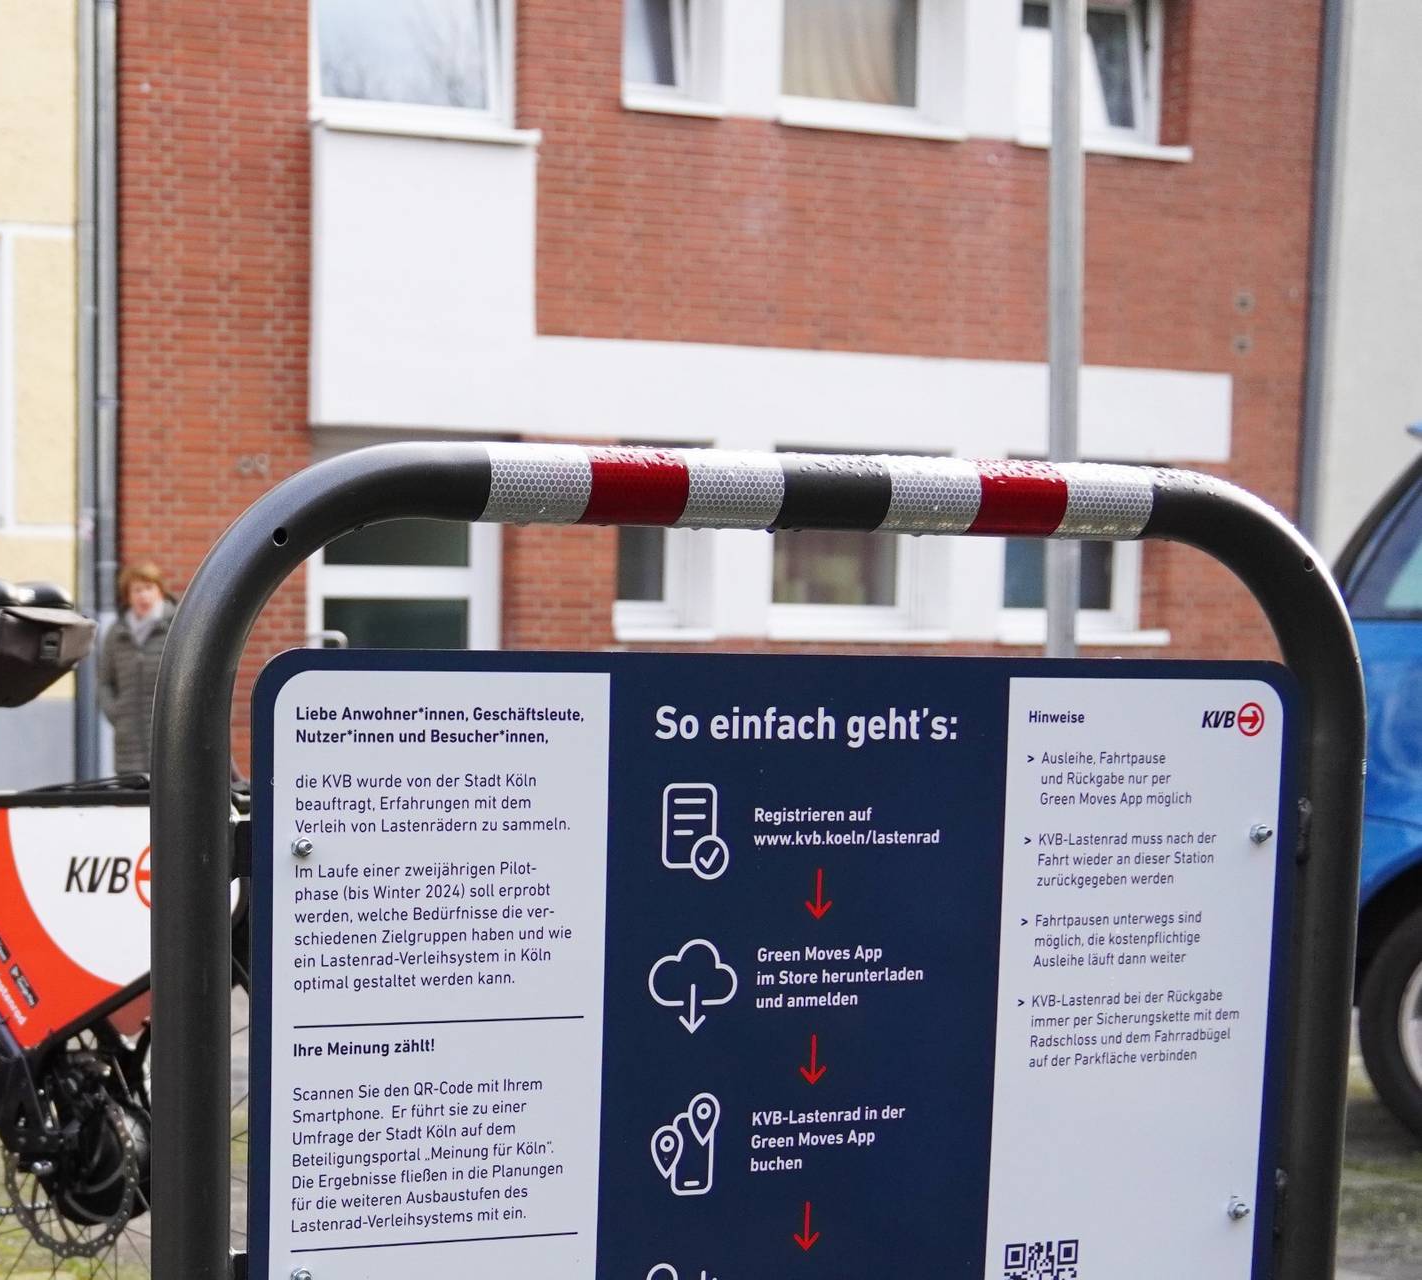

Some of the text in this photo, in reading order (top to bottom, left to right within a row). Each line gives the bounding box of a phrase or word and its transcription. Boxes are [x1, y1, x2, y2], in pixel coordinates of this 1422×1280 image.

[296, 706, 337, 721] Liebe
[473, 706, 584, 722] Geschäftsleute,
[654, 705, 699, 740] So
[710, 706, 836, 740] einfach
[1028, 710, 1085, 724] Hinweise
[1201, 710, 1235, 728] KVB
[399, 729, 426, 743] und
[1041, 751, 1166, 767] Ausleihe, Fahrtpause
[295, 773, 537, 789] die KVB wurde von der Stadt Köln
[1041, 771, 1172, 788] und Rückgabe nur per
[295, 795, 531, 814] beauftragt, Erfahrungen mit dem
[1040, 791, 1192, 808] Green Moves App möglich
[295, 816, 571, 834] Verleih von Lastenrädern zu sammeln.
[754, 806, 873, 826] Registrieren auf
[753, 829, 940, 846] www.kvb.koeln/lastenrad
[1038, 831, 1217, 846] KVB-Lastenrad muss nach der
[1037, 850, 1214, 866] Fahrt wieder an dieser Station
[65, 856, 132, 894] KVB
[295, 861, 537, 879] Im Laufe einer zweijährigen Pilot-
[295, 882, 551, 904] phase (bis Winter 2024) soll erprobt
[294, 904, 555, 924] werden, welche Bedürfnisse die ver-
[1035, 910, 1202, 929] Fahrtpausen unterwegs sind
[294, 925, 572, 946] schiedenen Zielgruppen haben und wie
[1034, 930, 1201, 950] möglich, die kostenpflichtige
[294, 947, 551, 969] ein Lastenrad-Verleihsystem in Köln
[757, 945, 883, 963] Green Moves App
[1033, 951, 1187, 967] Ausleihe läuft dann weiter
[293, 971, 515, 993] optimal gestaltet werden kann.
[756, 966, 924, 986] im Store herunterladen
[756, 991, 858, 1009] und anmelden
[293, 1038, 435, 1057] Ihre Meinung zählt!
[292, 1078, 543, 1102] Scannen Sie den QR-Code mit Ihrem
[292, 1100, 527, 1124] Smartphone. Er führt sie zu einer
[752, 1104, 906, 1126] KVB-Lastenrad in der
[292, 1122, 516, 1147] Umfrage der Stadt Köln auf dem
[751, 1129, 876, 1149] Green Moves App
[750, 1155, 803, 1172] buchen
